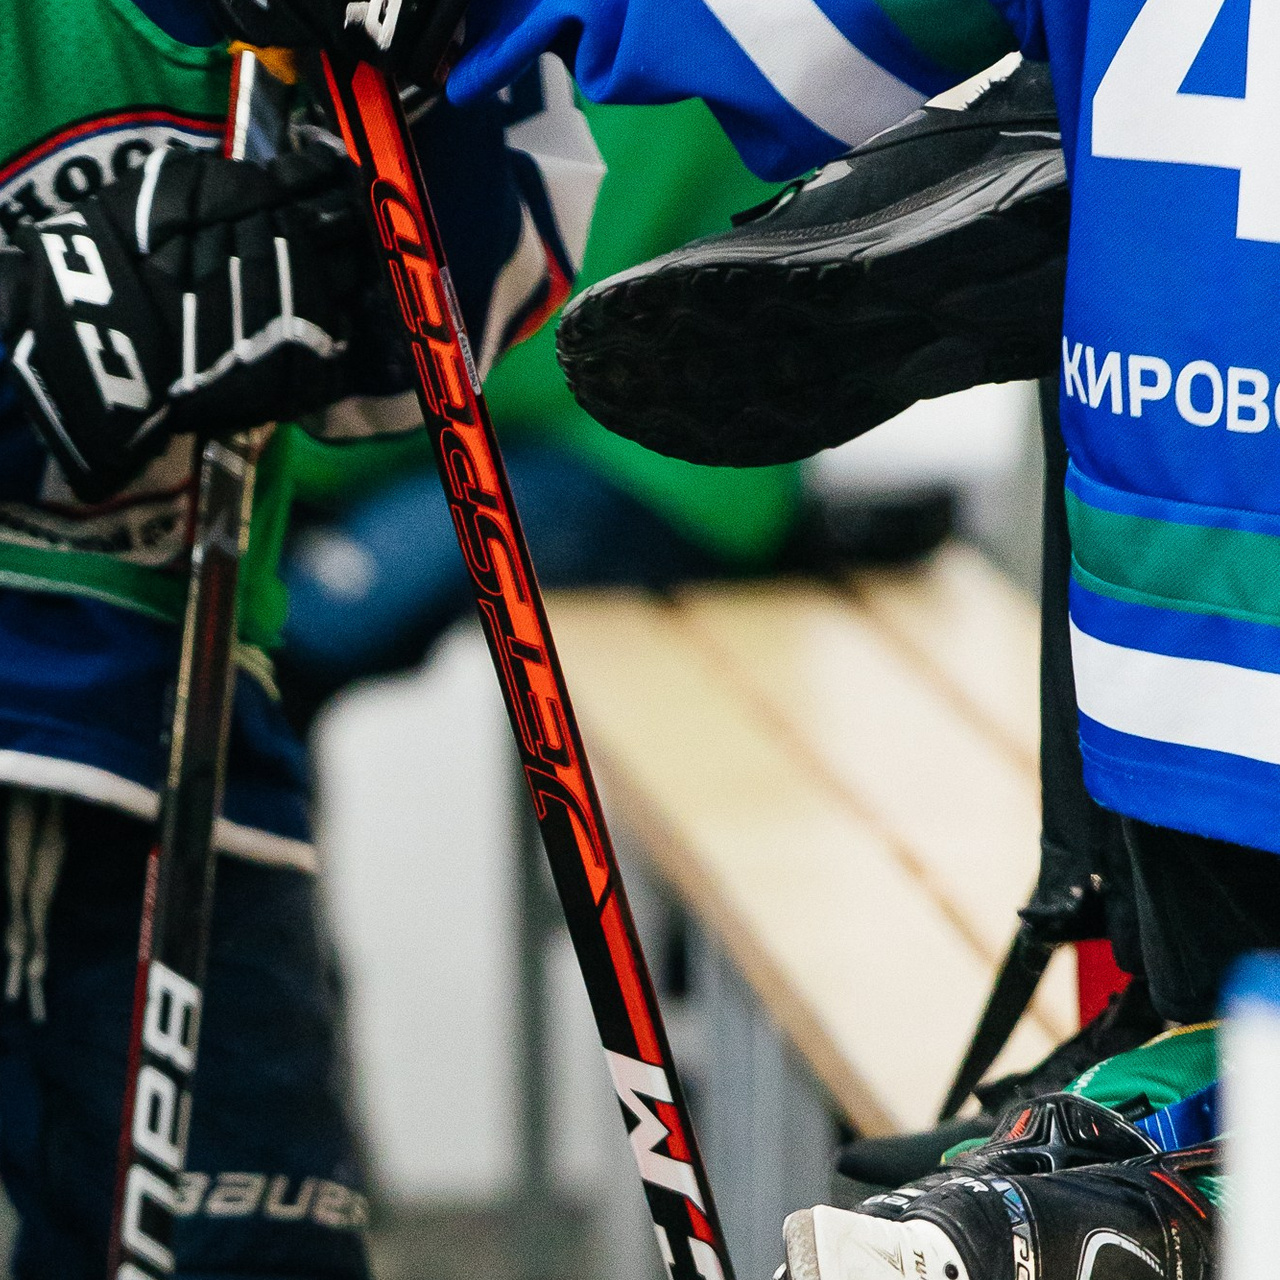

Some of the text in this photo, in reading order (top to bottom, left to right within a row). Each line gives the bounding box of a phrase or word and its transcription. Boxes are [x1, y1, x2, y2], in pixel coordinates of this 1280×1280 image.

[35, 211, 153, 412] CC
[1061, 335, 1280, 434] КИРОВ
[370, 178, 606, 872] JETSPEED
